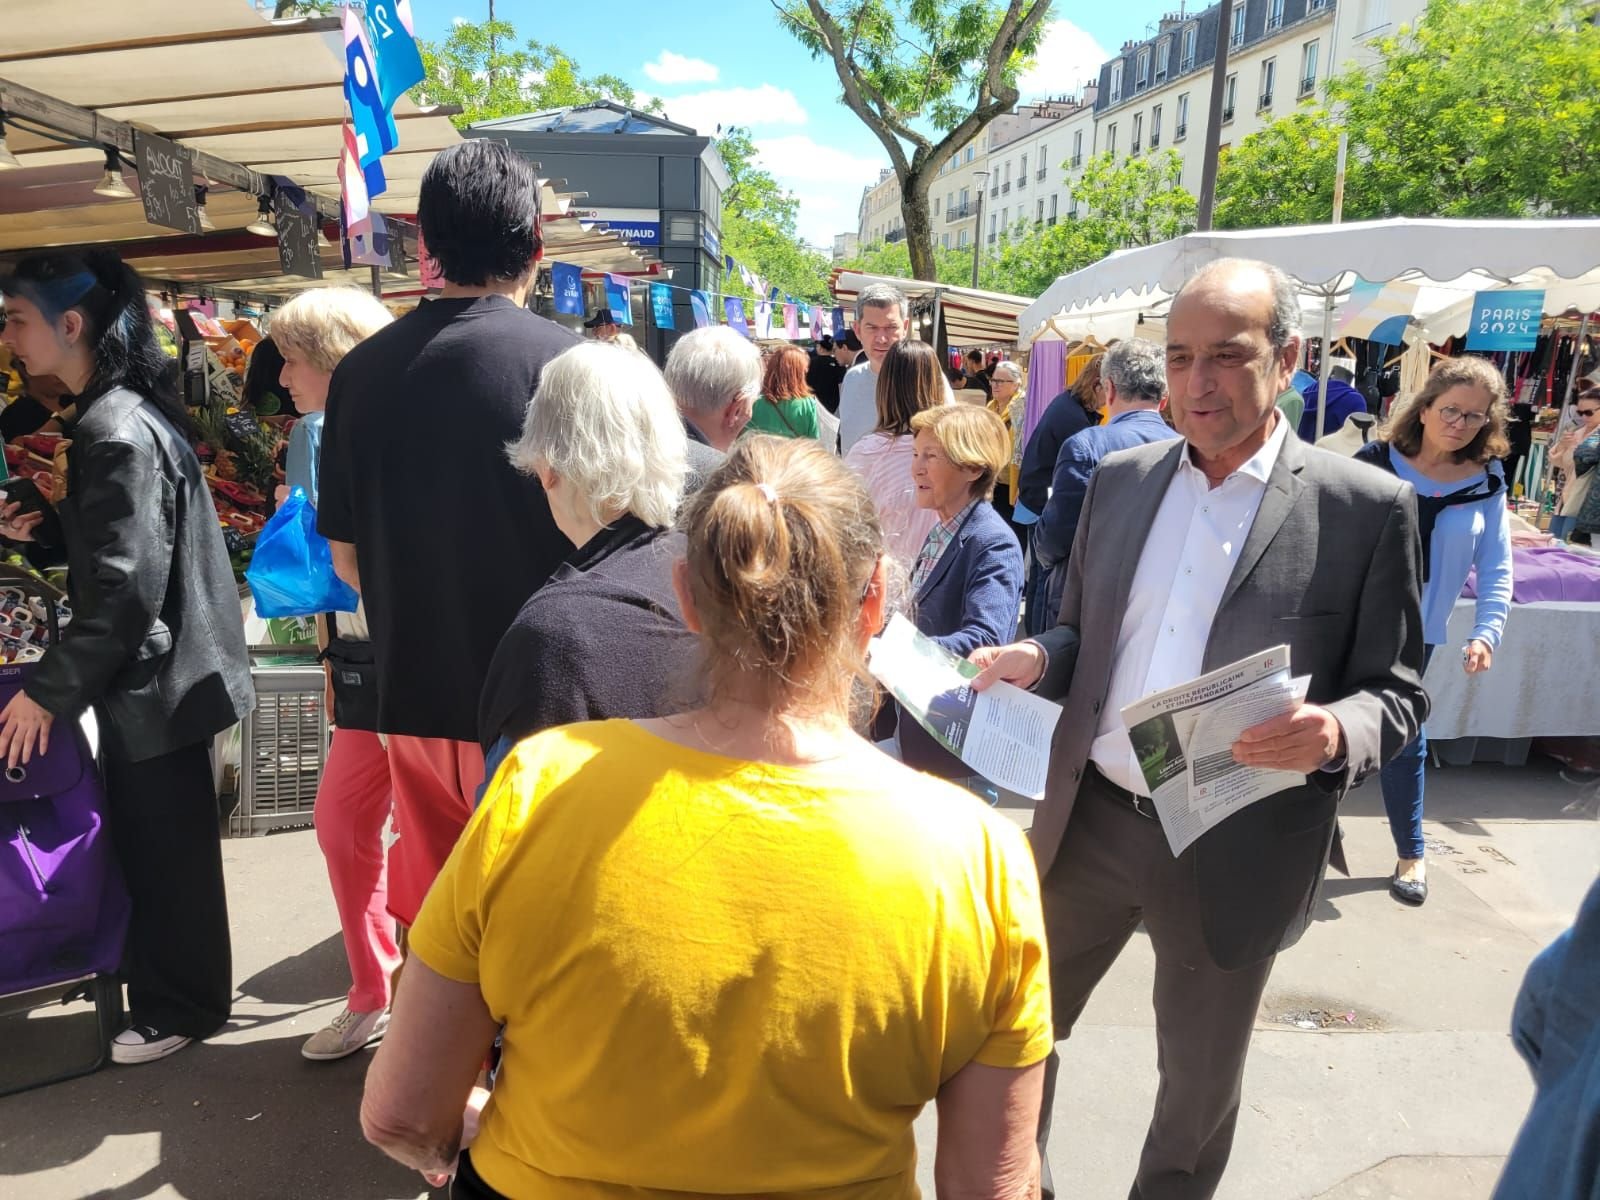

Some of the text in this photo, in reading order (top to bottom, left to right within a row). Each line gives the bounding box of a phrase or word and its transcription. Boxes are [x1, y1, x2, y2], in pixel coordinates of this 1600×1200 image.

[611, 228, 655, 239] YNAUD
[1480, 321, 1528, 334] 2024
[1151, 671, 1245, 710] LA DROITE RÉPUBLICAINE
[1165, 682, 1233, 711] ET INDÉPENDANTE
